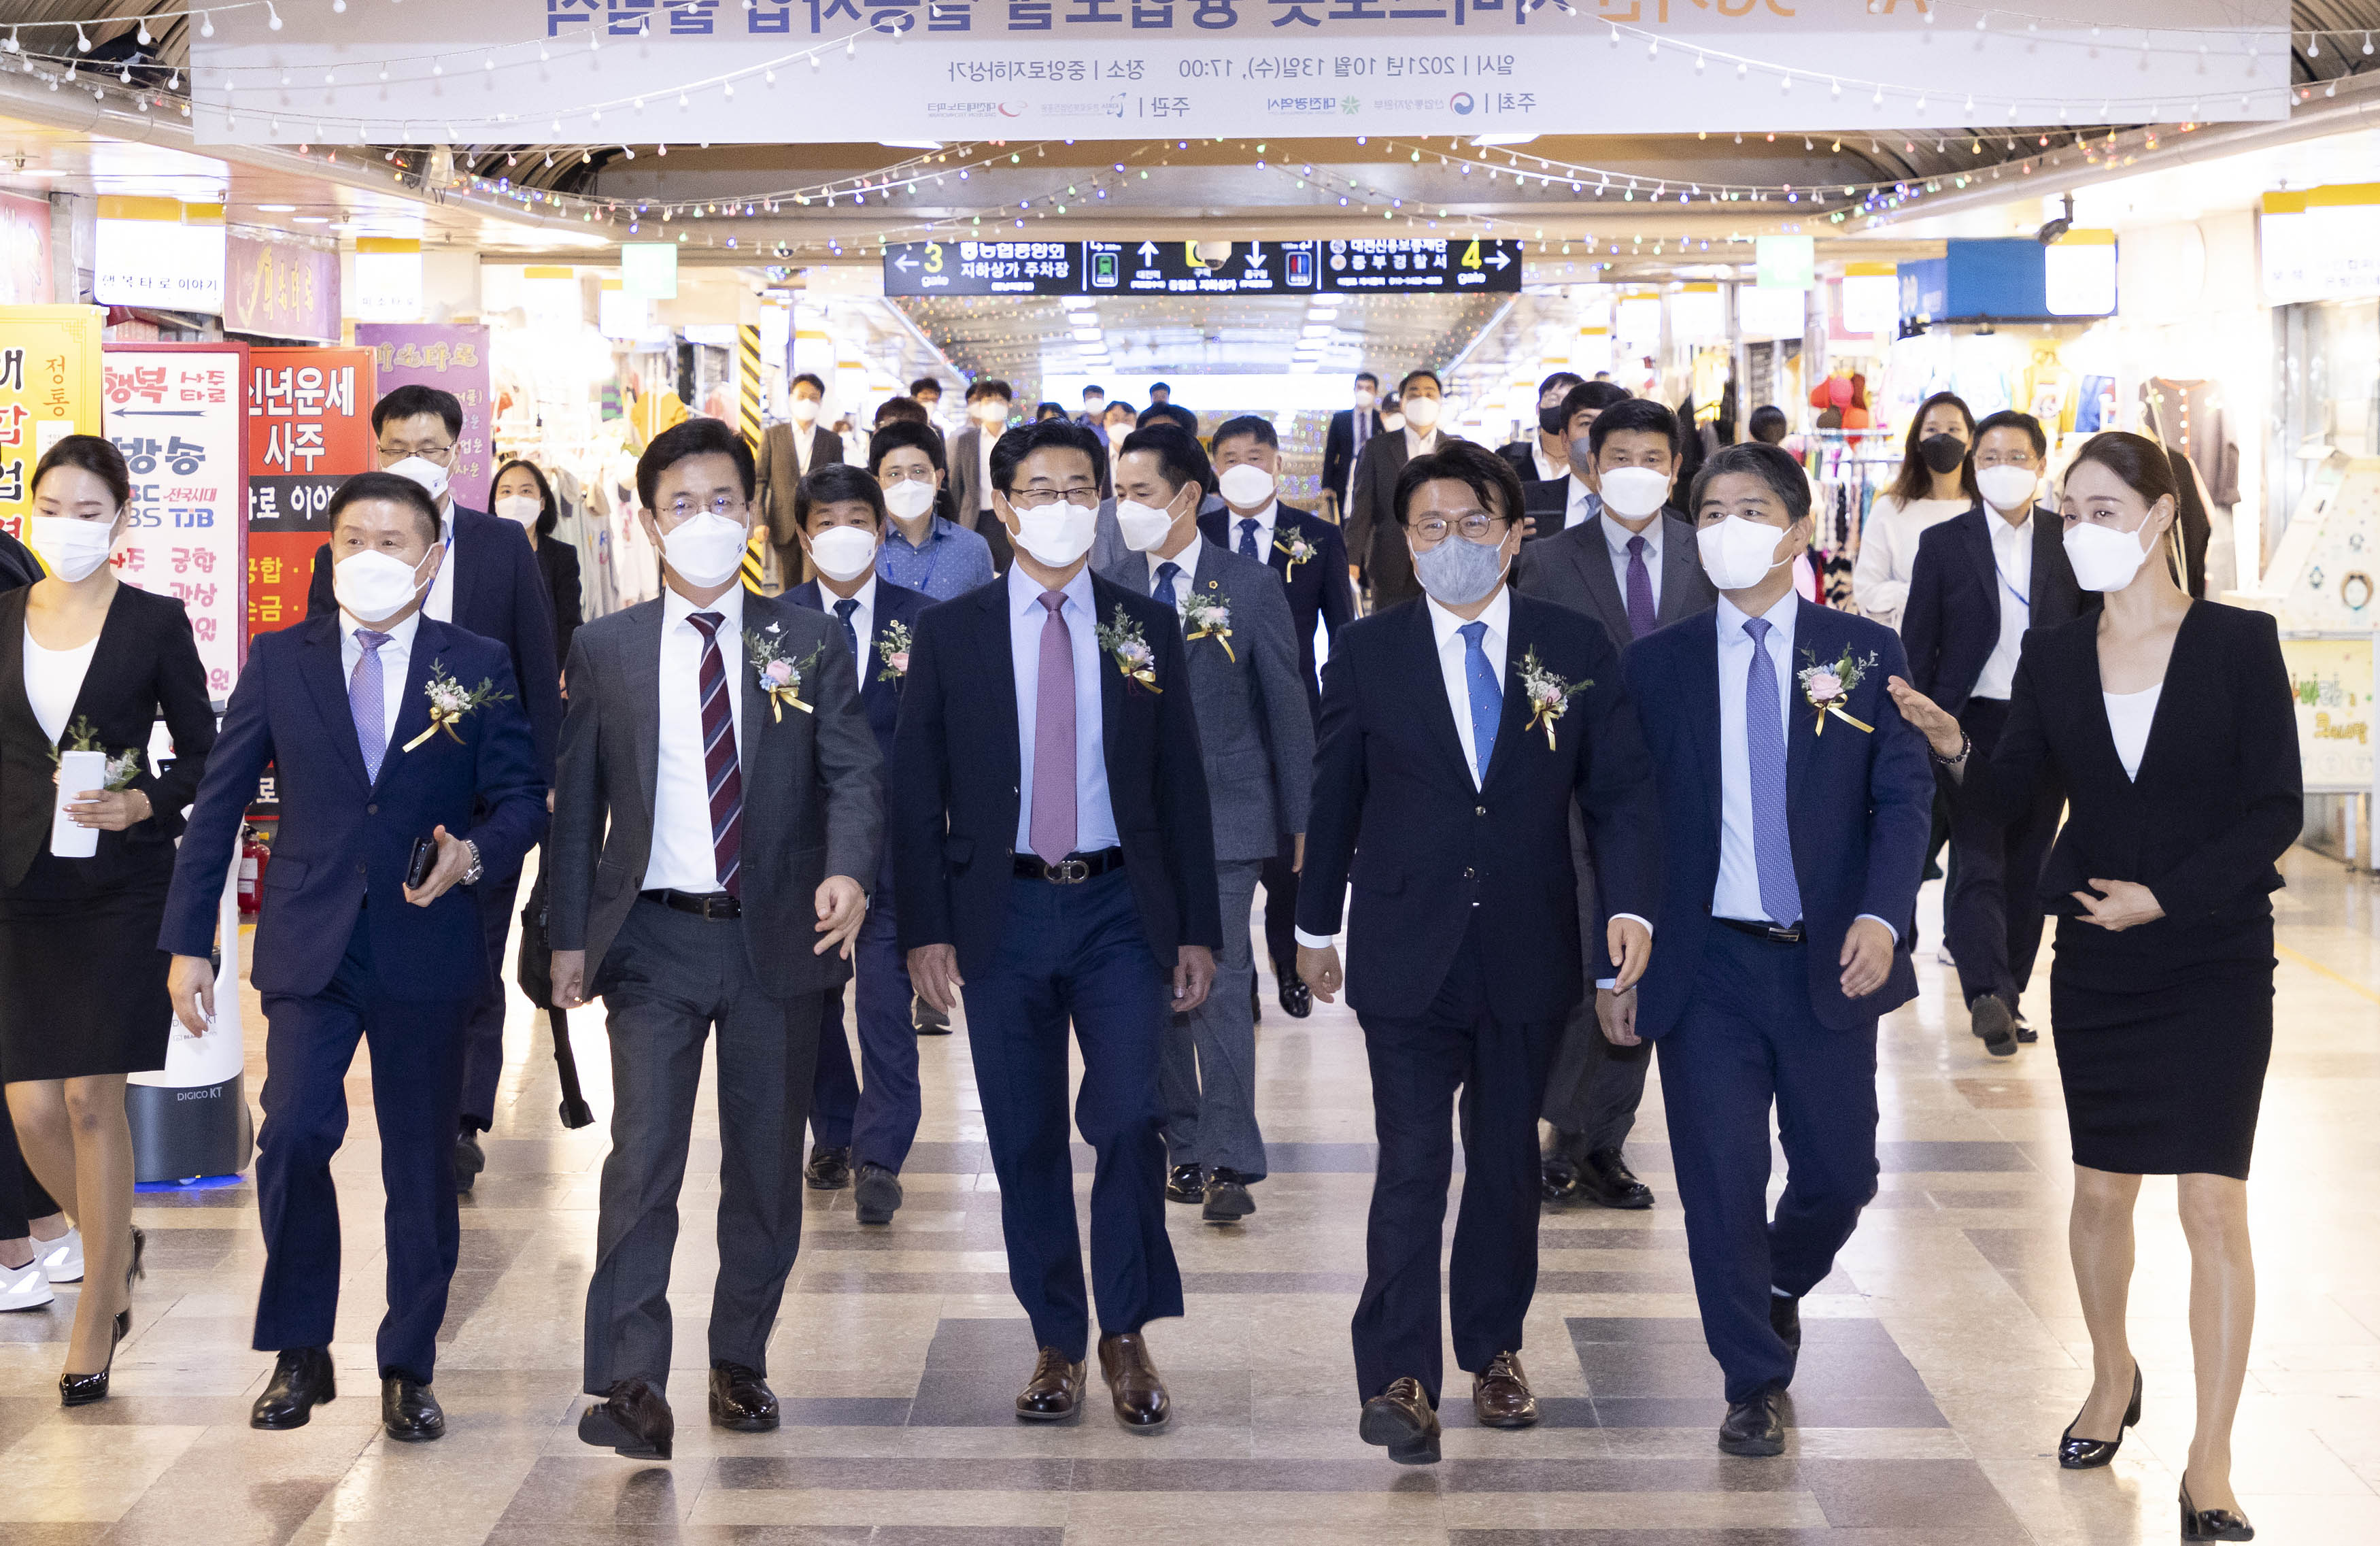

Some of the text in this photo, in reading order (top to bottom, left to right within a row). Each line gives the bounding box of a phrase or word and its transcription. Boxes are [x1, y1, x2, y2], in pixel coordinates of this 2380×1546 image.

[924, 243, 944, 273] 3
[1461, 240, 1482, 270] 4
[961, 261, 1070, 279] 지하상가 주차장
[179, 278, 217, 291] 이야기
[44, 355, 70, 416] 정통
[105, 367, 168, 403] 행복
[181, 371, 225, 386] 사주
[180, 388, 226, 403] 타로
[112, 436, 206, 475] 방송
[263, 422, 326, 473] 사주
[290, 485, 339, 521] 이야
[169, 508, 214, 528] TJB
[171, 548, 216, 573] 궁합
[177, 1087, 222, 1101] DIGICO KT
